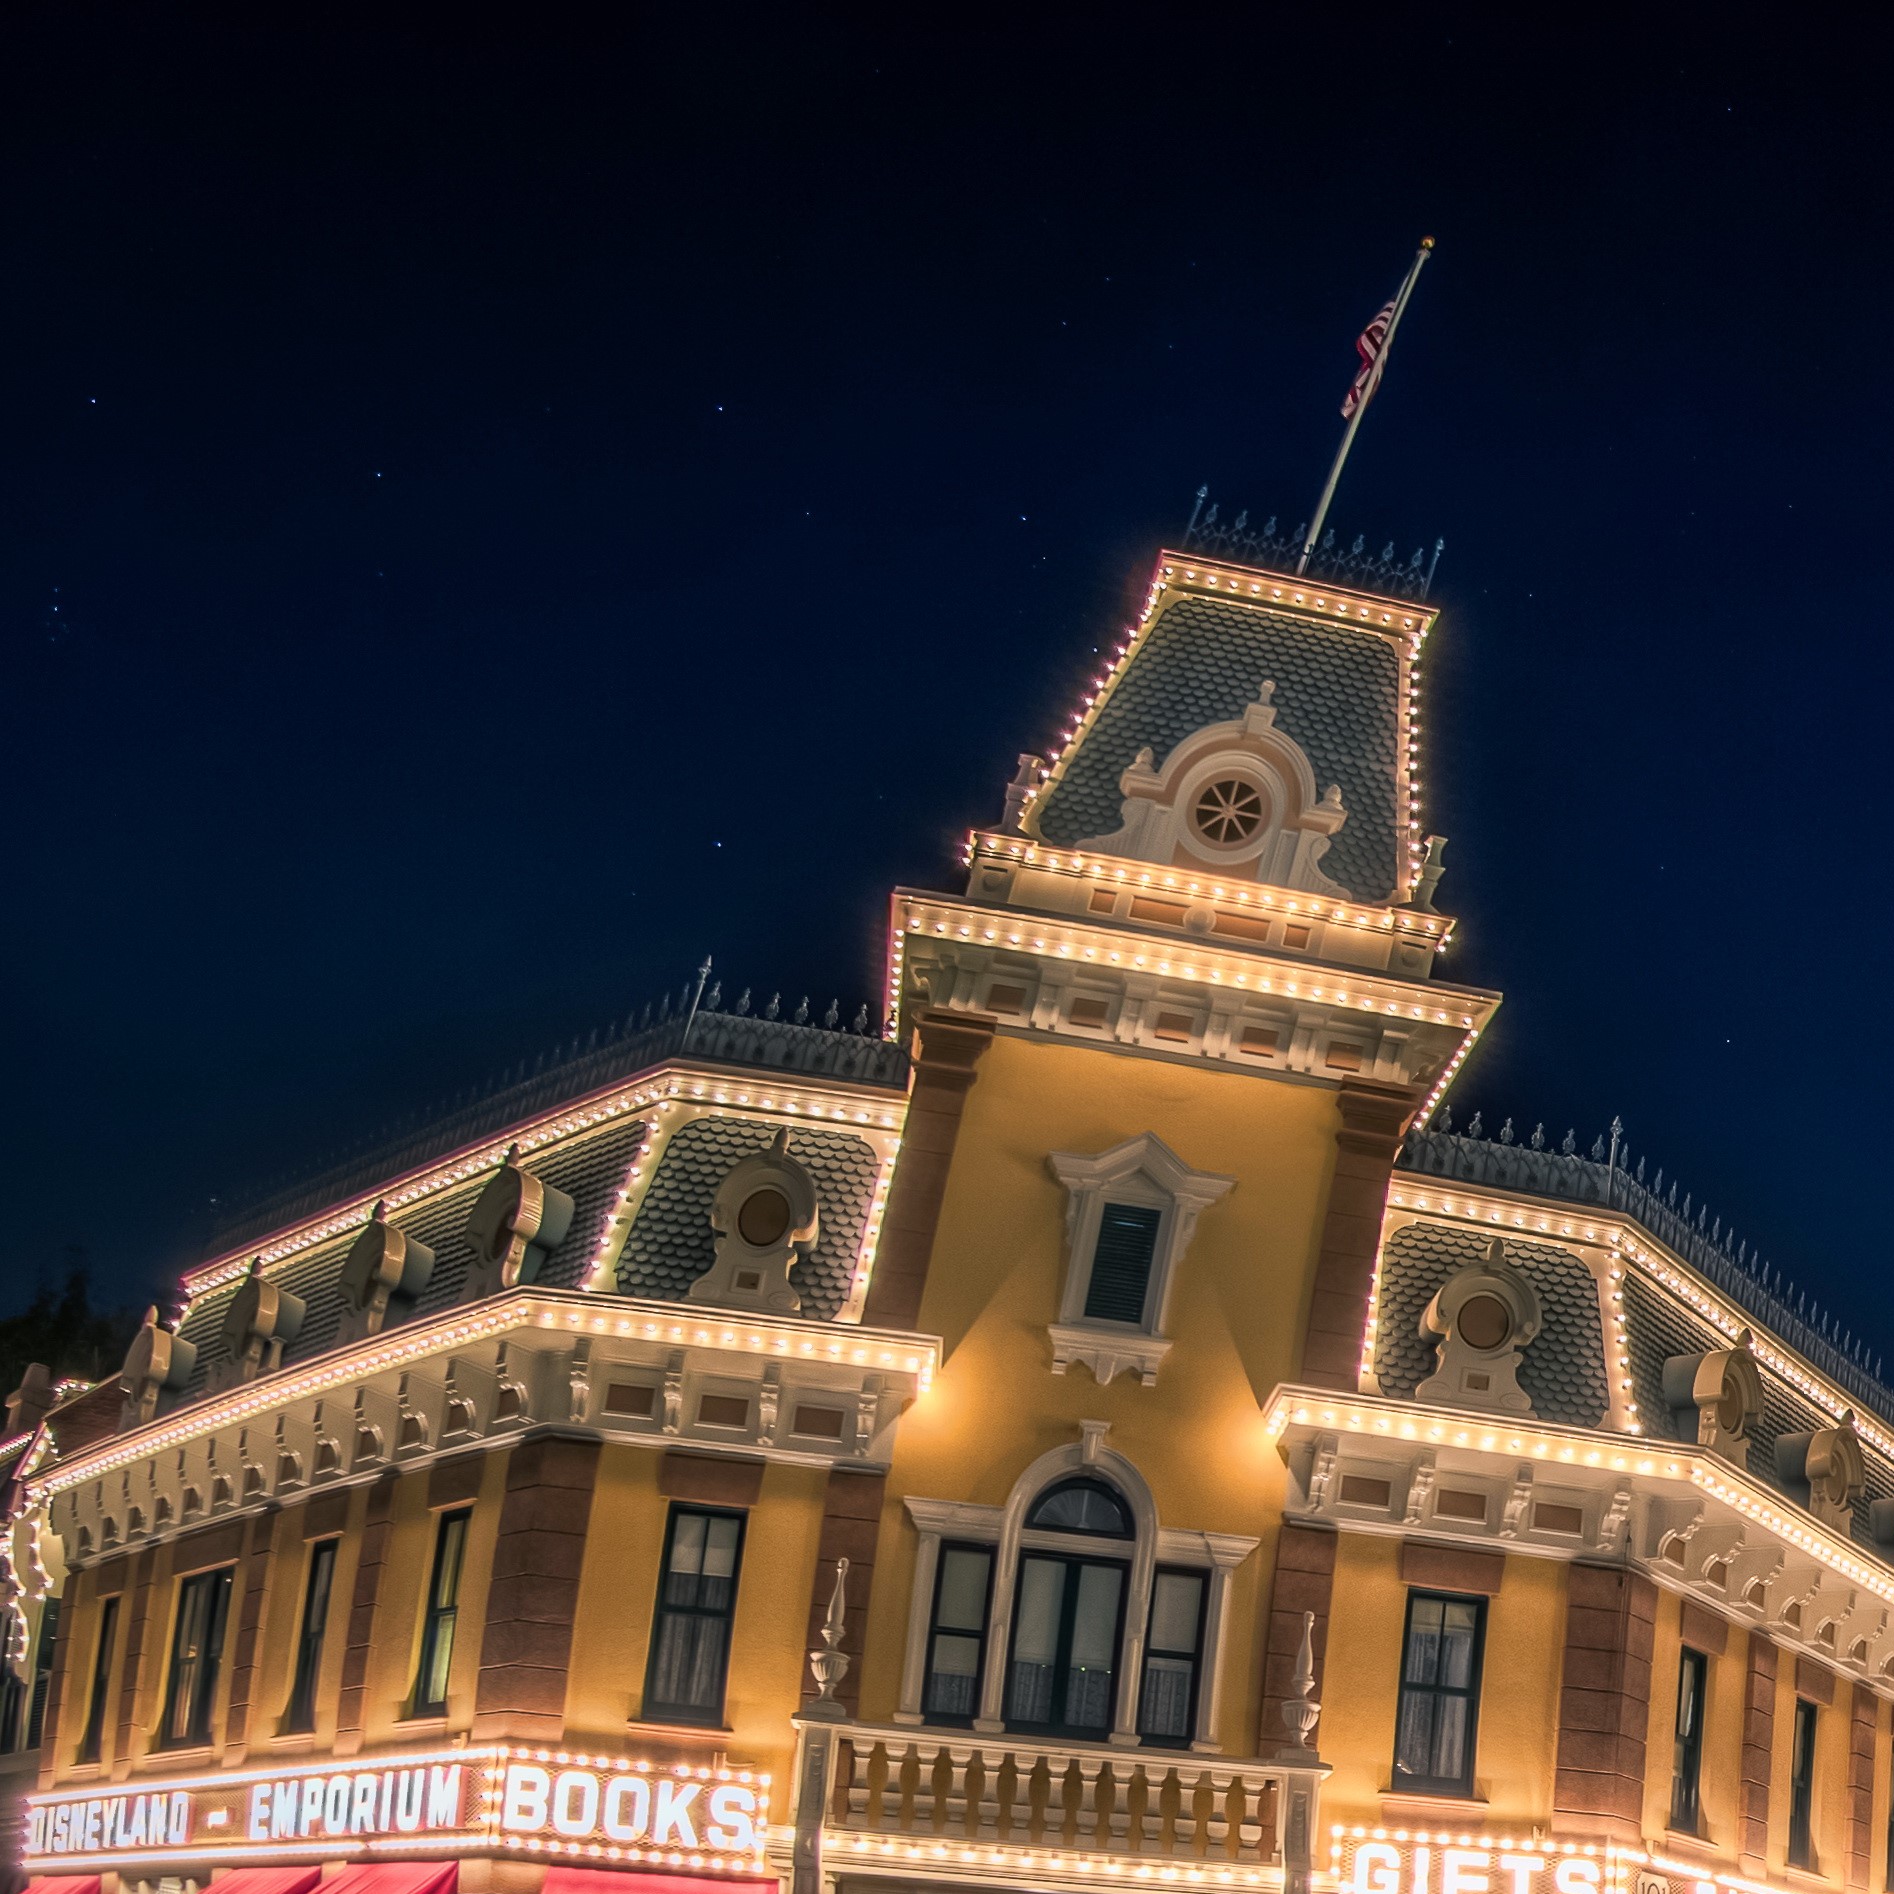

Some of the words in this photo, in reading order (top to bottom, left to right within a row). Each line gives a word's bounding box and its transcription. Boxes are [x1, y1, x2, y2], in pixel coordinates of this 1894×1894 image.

[29, 1791, 191, 1853] DISNEYLAND
[249, 1764, 461, 1840] EMPORIUM
[502, 1764, 758, 1851] BOOKS
